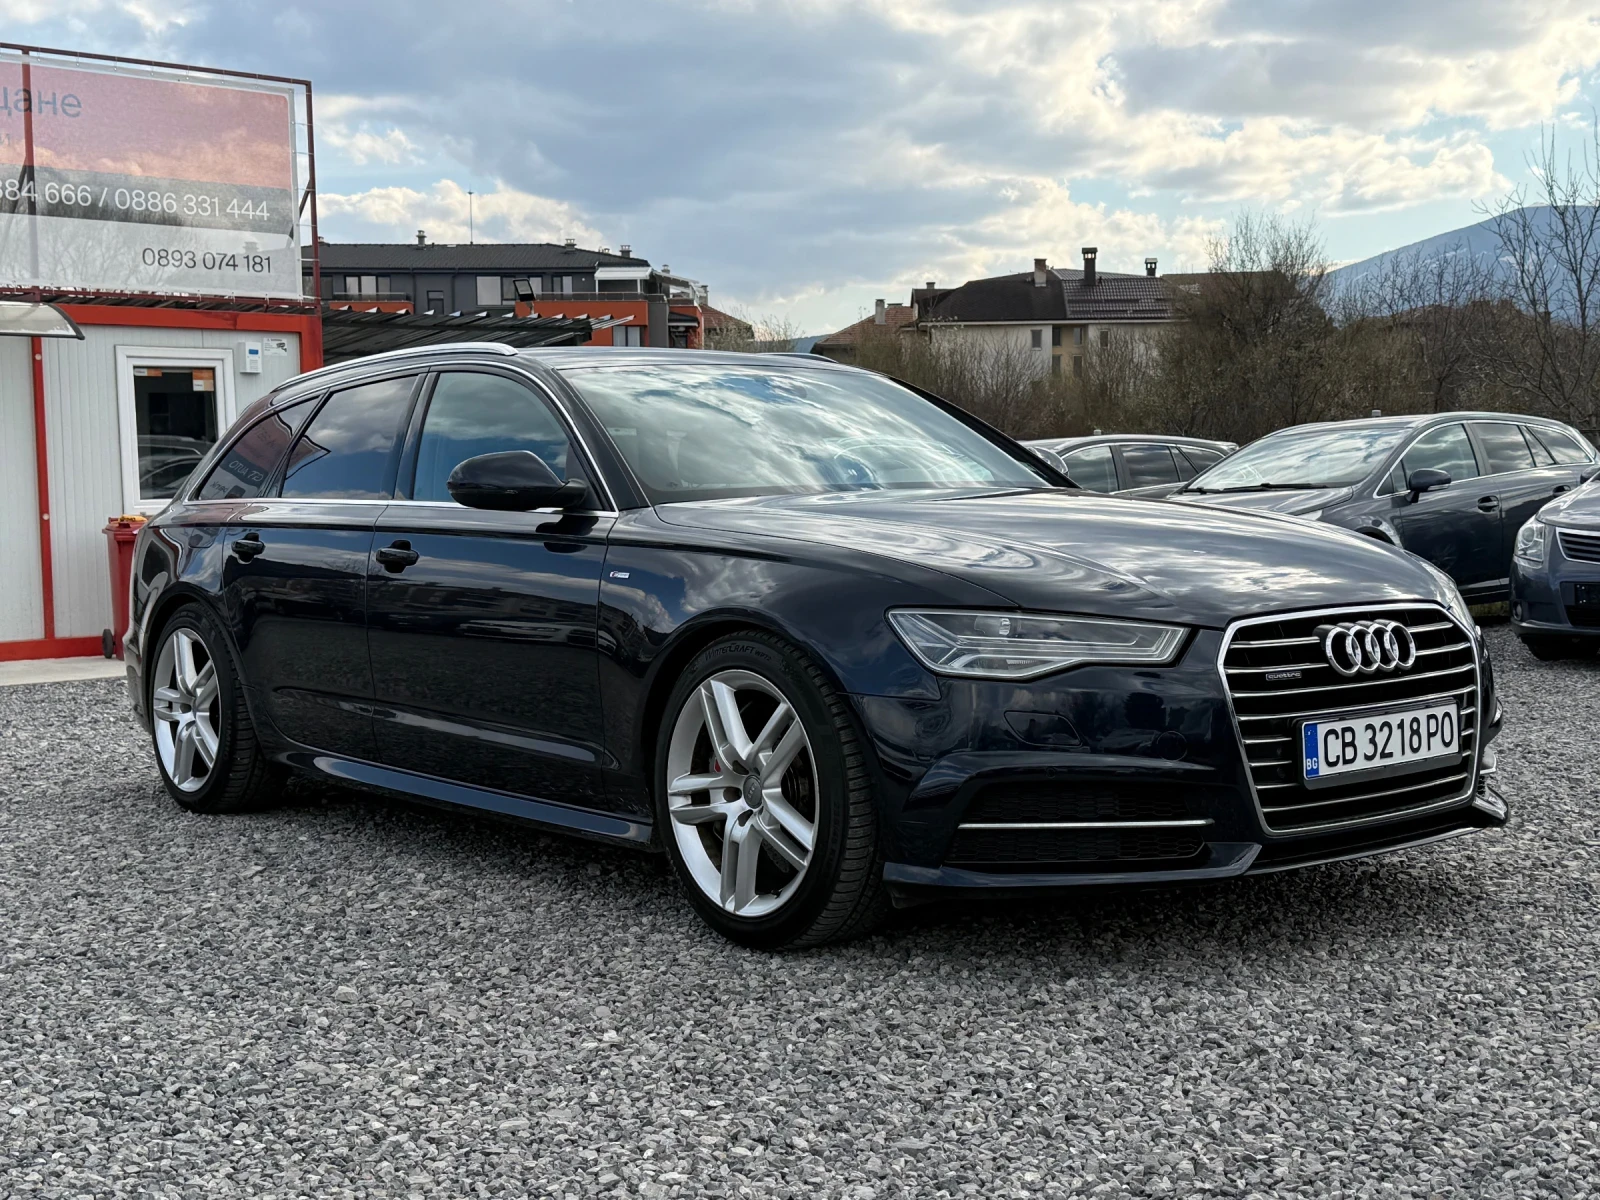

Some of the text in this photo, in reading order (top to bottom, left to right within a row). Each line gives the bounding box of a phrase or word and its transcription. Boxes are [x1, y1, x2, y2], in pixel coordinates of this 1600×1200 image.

[0, 178, 270, 221] 84 666 / 0886 331 444
[142, 247, 272, 274] 0893 074 181
[1363, 716, 1423, 762] 3218
[1306, 757, 1318, 770] BG
